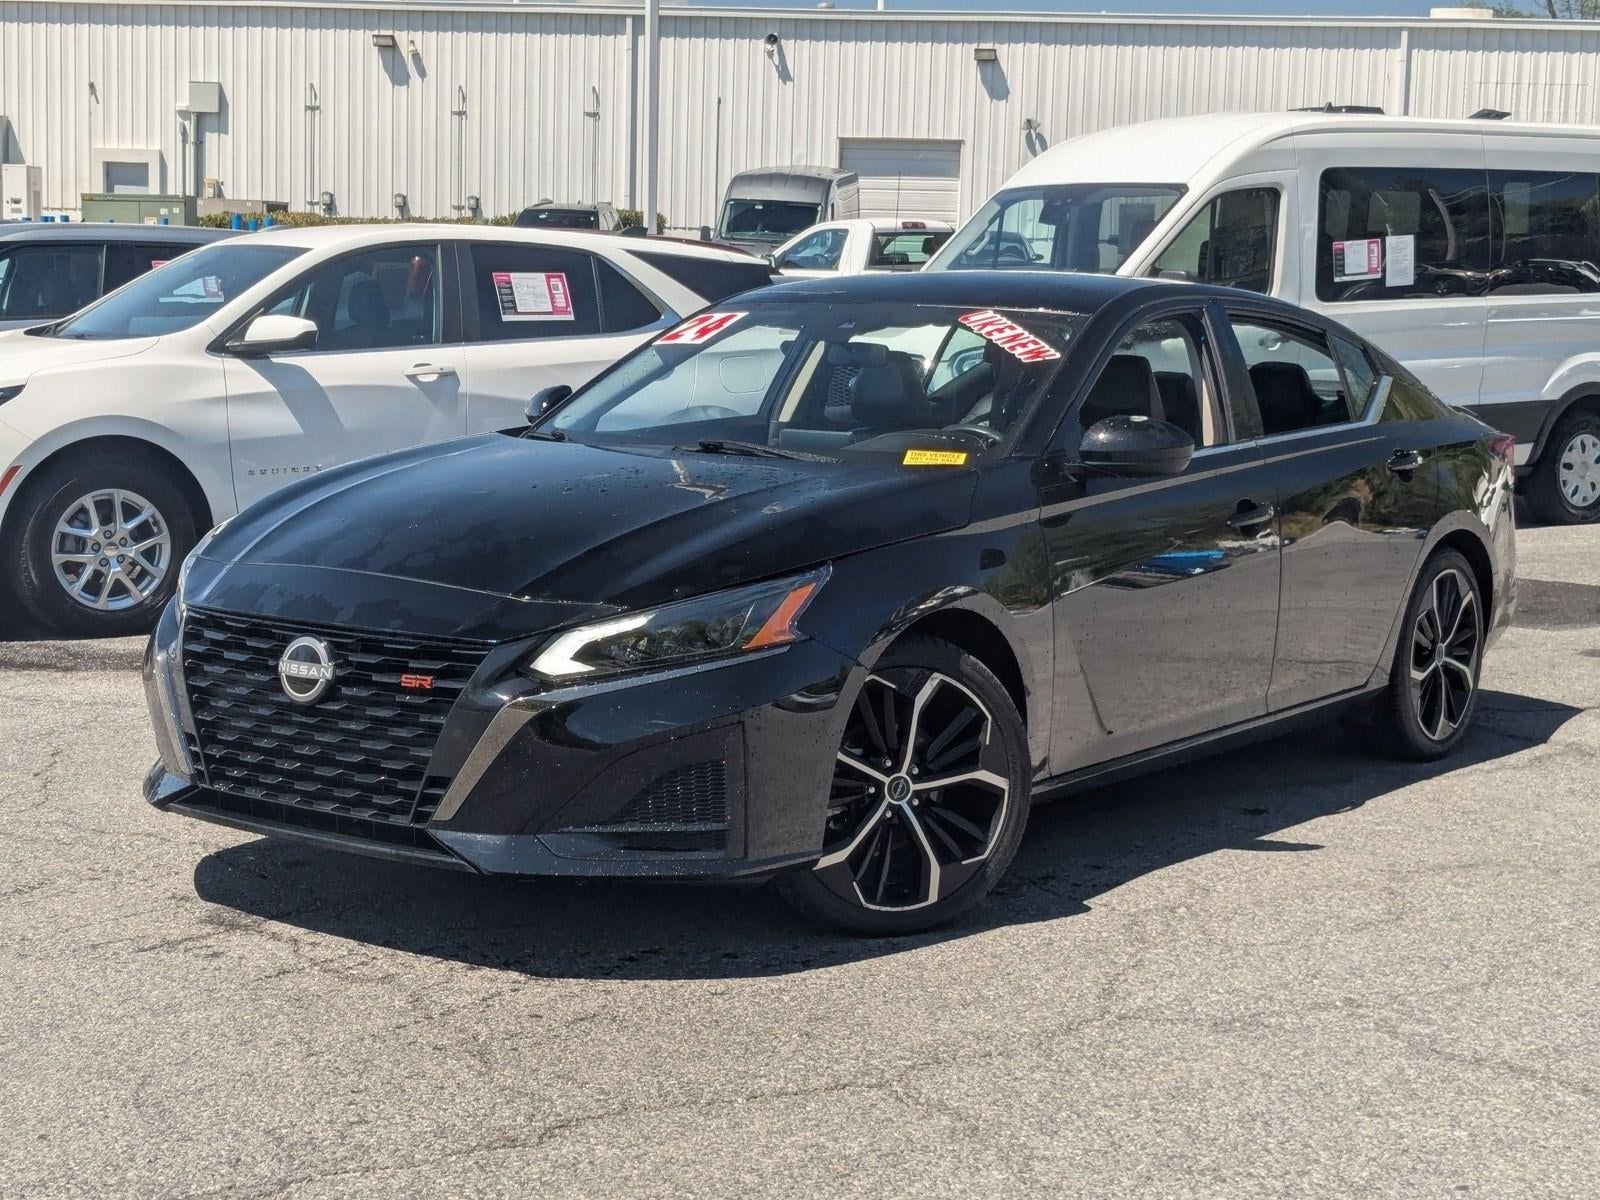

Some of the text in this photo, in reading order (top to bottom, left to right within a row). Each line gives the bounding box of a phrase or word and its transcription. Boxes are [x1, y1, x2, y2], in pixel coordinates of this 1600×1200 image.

[659, 313, 738, 341] 24
[278, 661, 332, 678] NISSAN
[400, 673, 433, 689] SR
